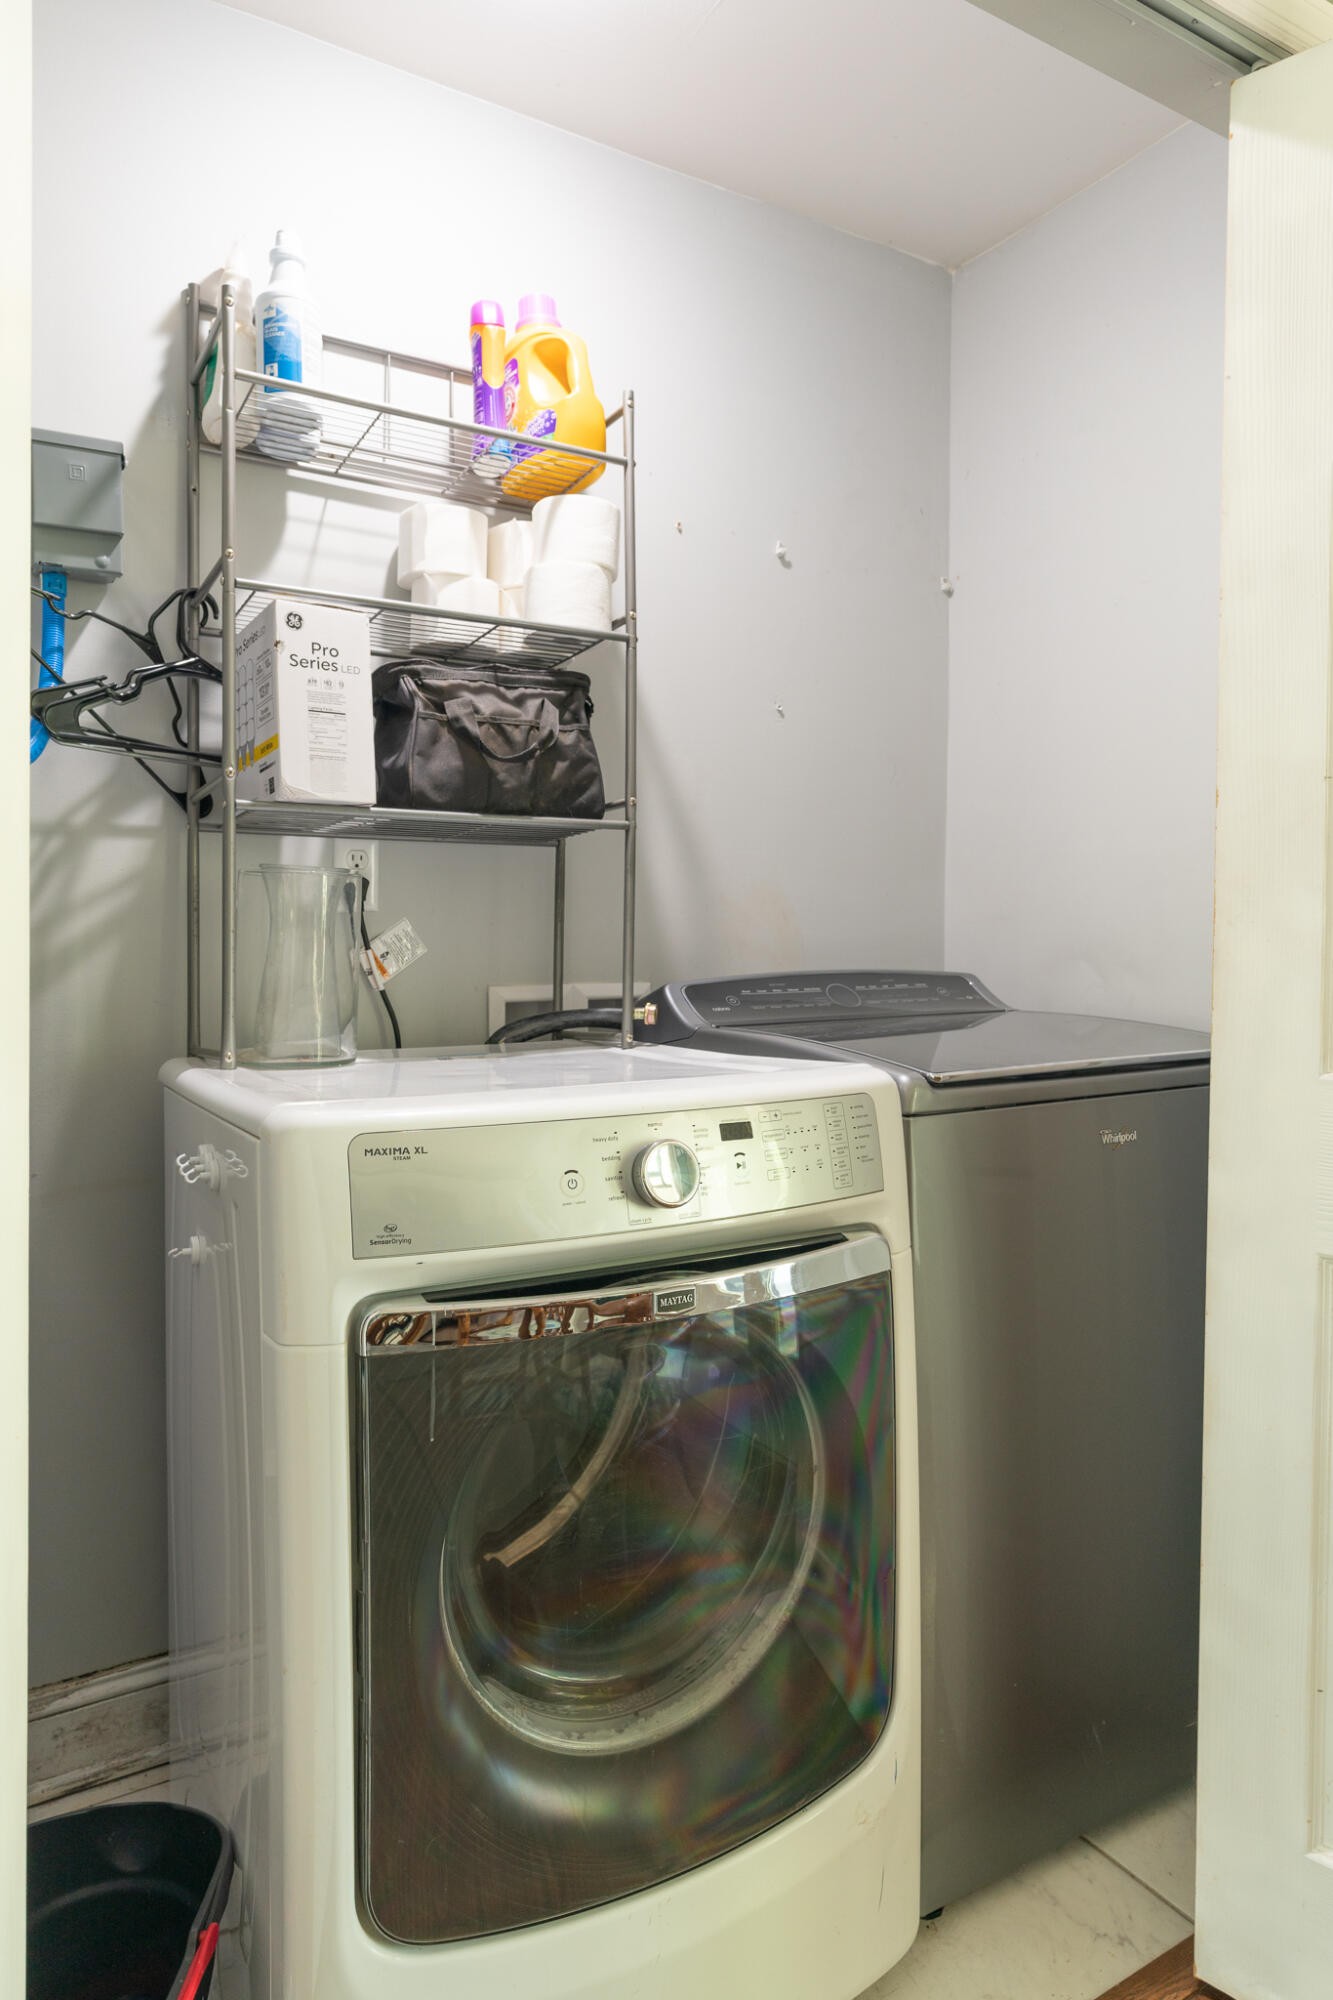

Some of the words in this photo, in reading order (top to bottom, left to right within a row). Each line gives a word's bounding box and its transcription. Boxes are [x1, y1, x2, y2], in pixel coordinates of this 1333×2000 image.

[311, 642, 339, 658] Pro
[289, 653, 338, 673] Series
[340, 664, 361, 675] LED
[1101, 1130, 1137, 1145] Whirlpool
[364, 1147, 410, 1157] MAXIMA
[414, 1146, 428, 1154] XL
[369, 1237, 412, 1246] SensorDrying
[660, 1293, 693, 1308] MAYTAG
